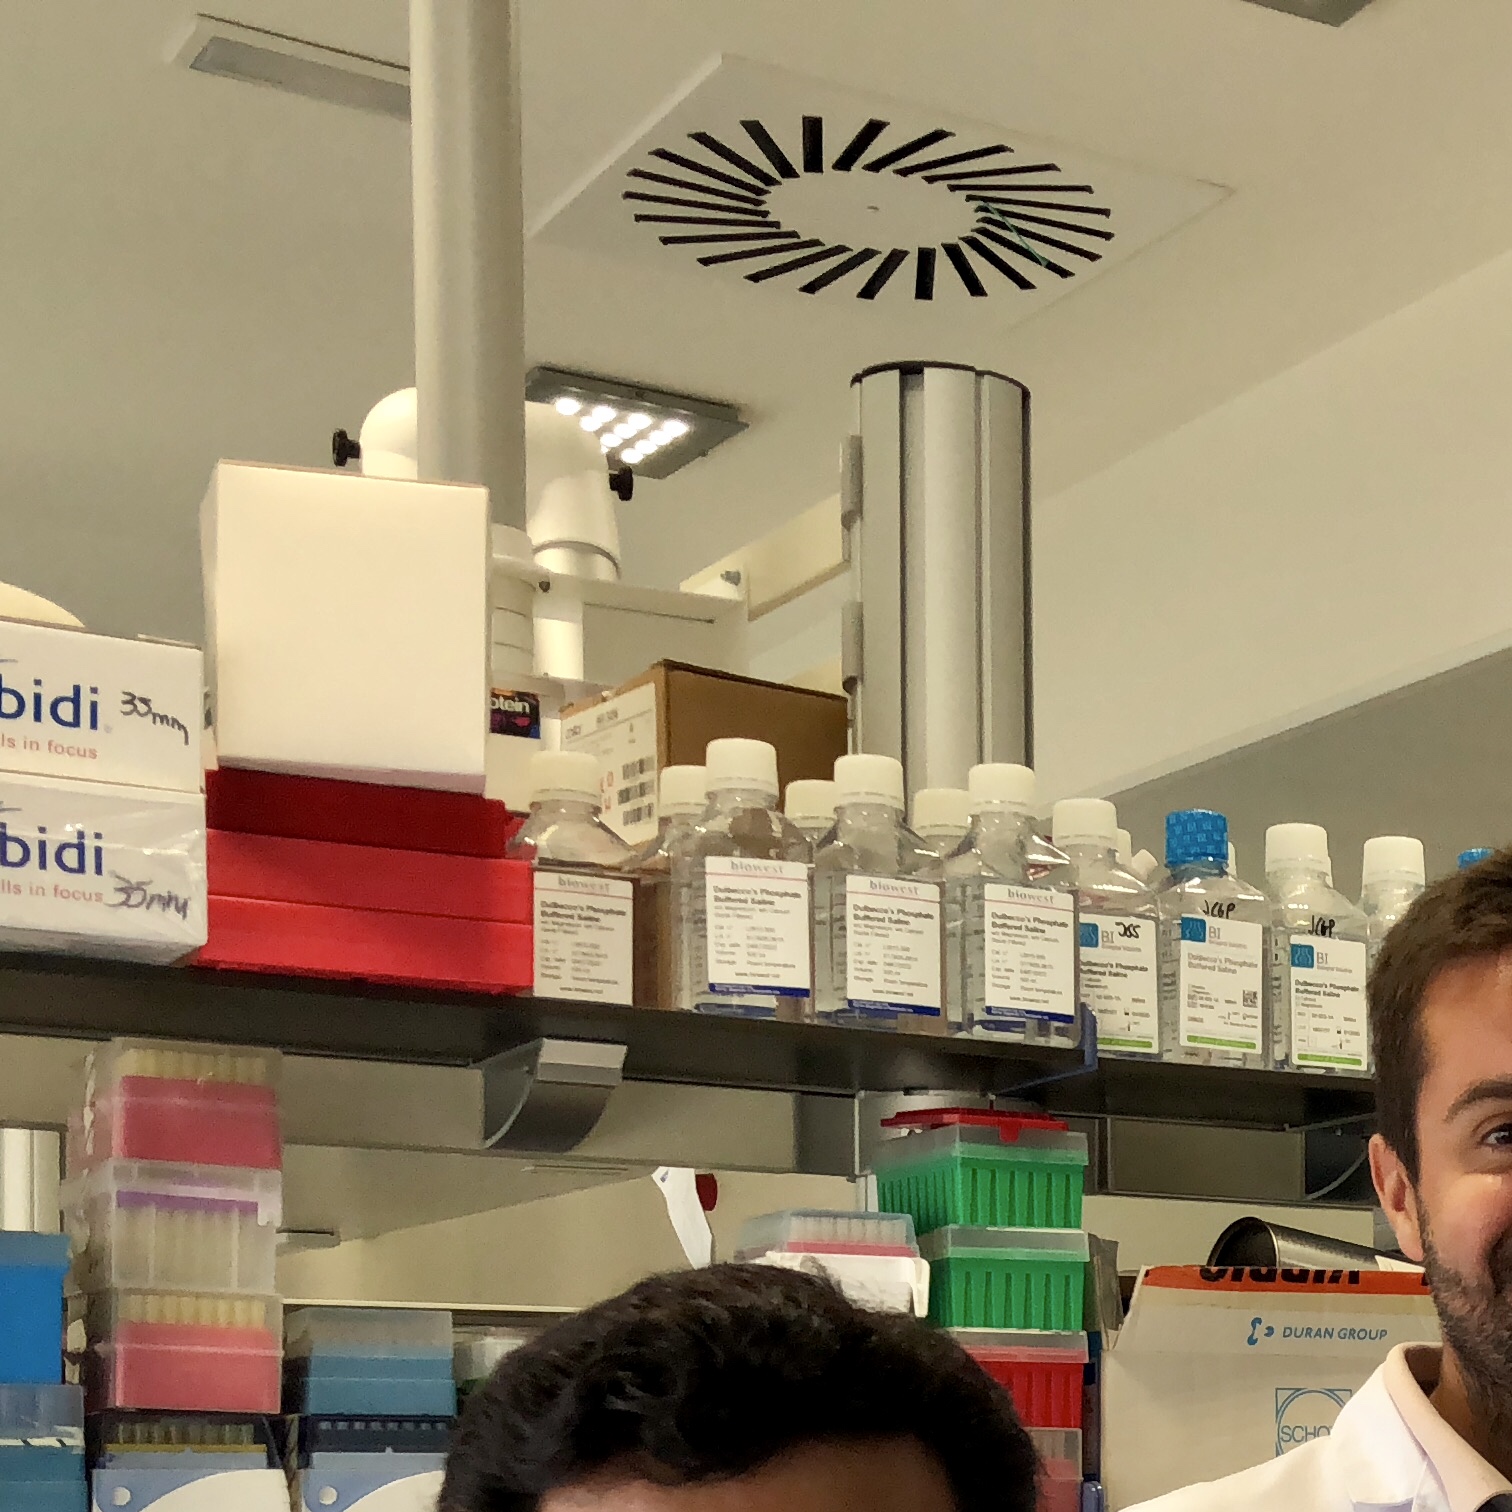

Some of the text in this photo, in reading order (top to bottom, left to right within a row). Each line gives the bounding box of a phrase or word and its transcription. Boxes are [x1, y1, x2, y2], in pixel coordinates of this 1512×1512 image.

[23, 738, 39, 751] in
[48, 740, 98, 759] focus
[29, 882, 45, 897] in
[54, 885, 103, 902] focus
[1007, 888, 1054, 904] biowest
[1101, 930, 1115, 944] BI
[1208, 926, 1221, 939] BI
[1317, 952, 1328, 964] BI
[1282, 1326, 1388, 1340] DURAN GROUP
[1280, 1425, 1332, 1443] SCHO
